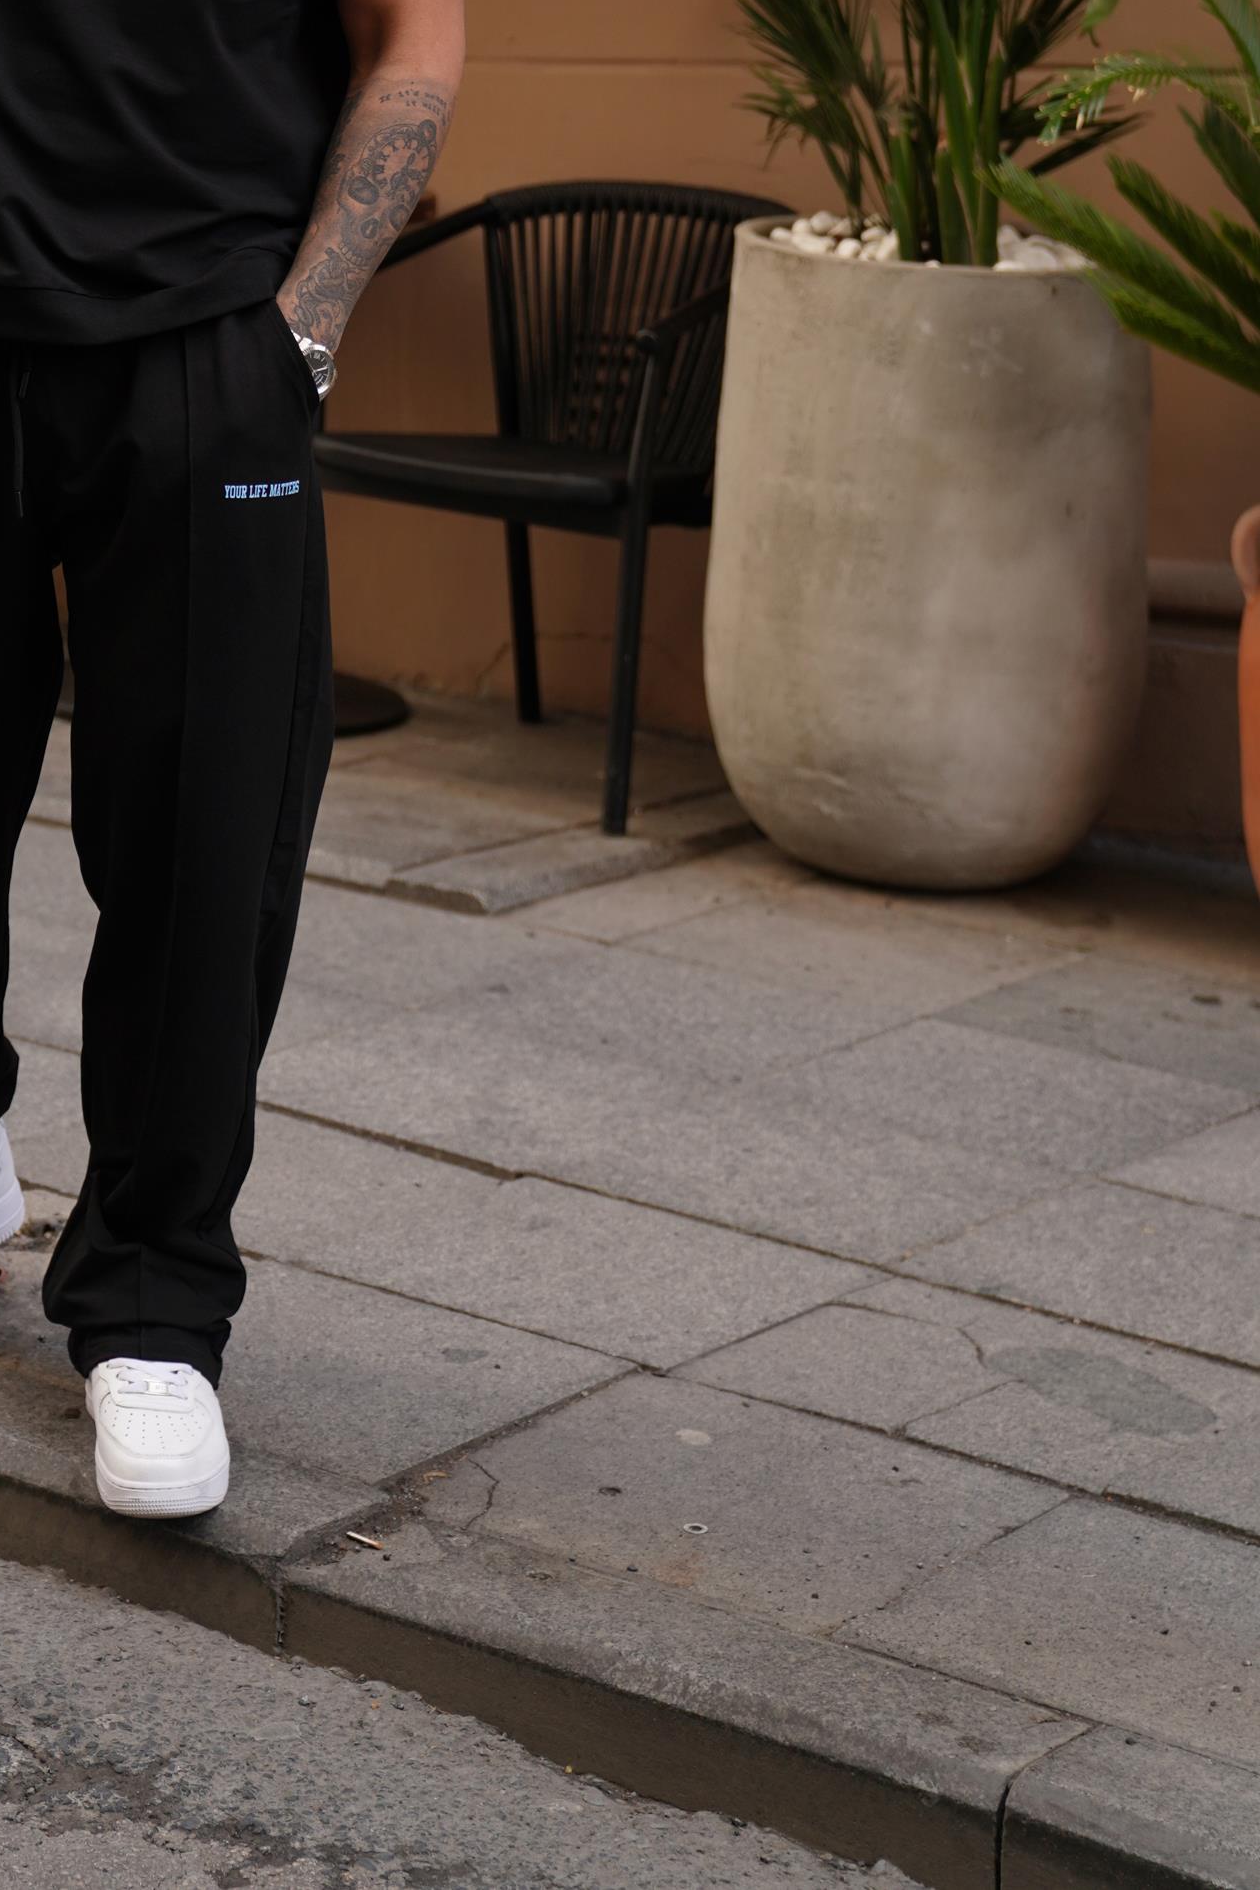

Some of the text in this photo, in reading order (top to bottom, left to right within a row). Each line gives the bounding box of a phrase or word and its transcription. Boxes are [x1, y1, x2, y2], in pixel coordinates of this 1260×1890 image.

[224, 480, 300, 499] YOUR LIFE MATTERS
